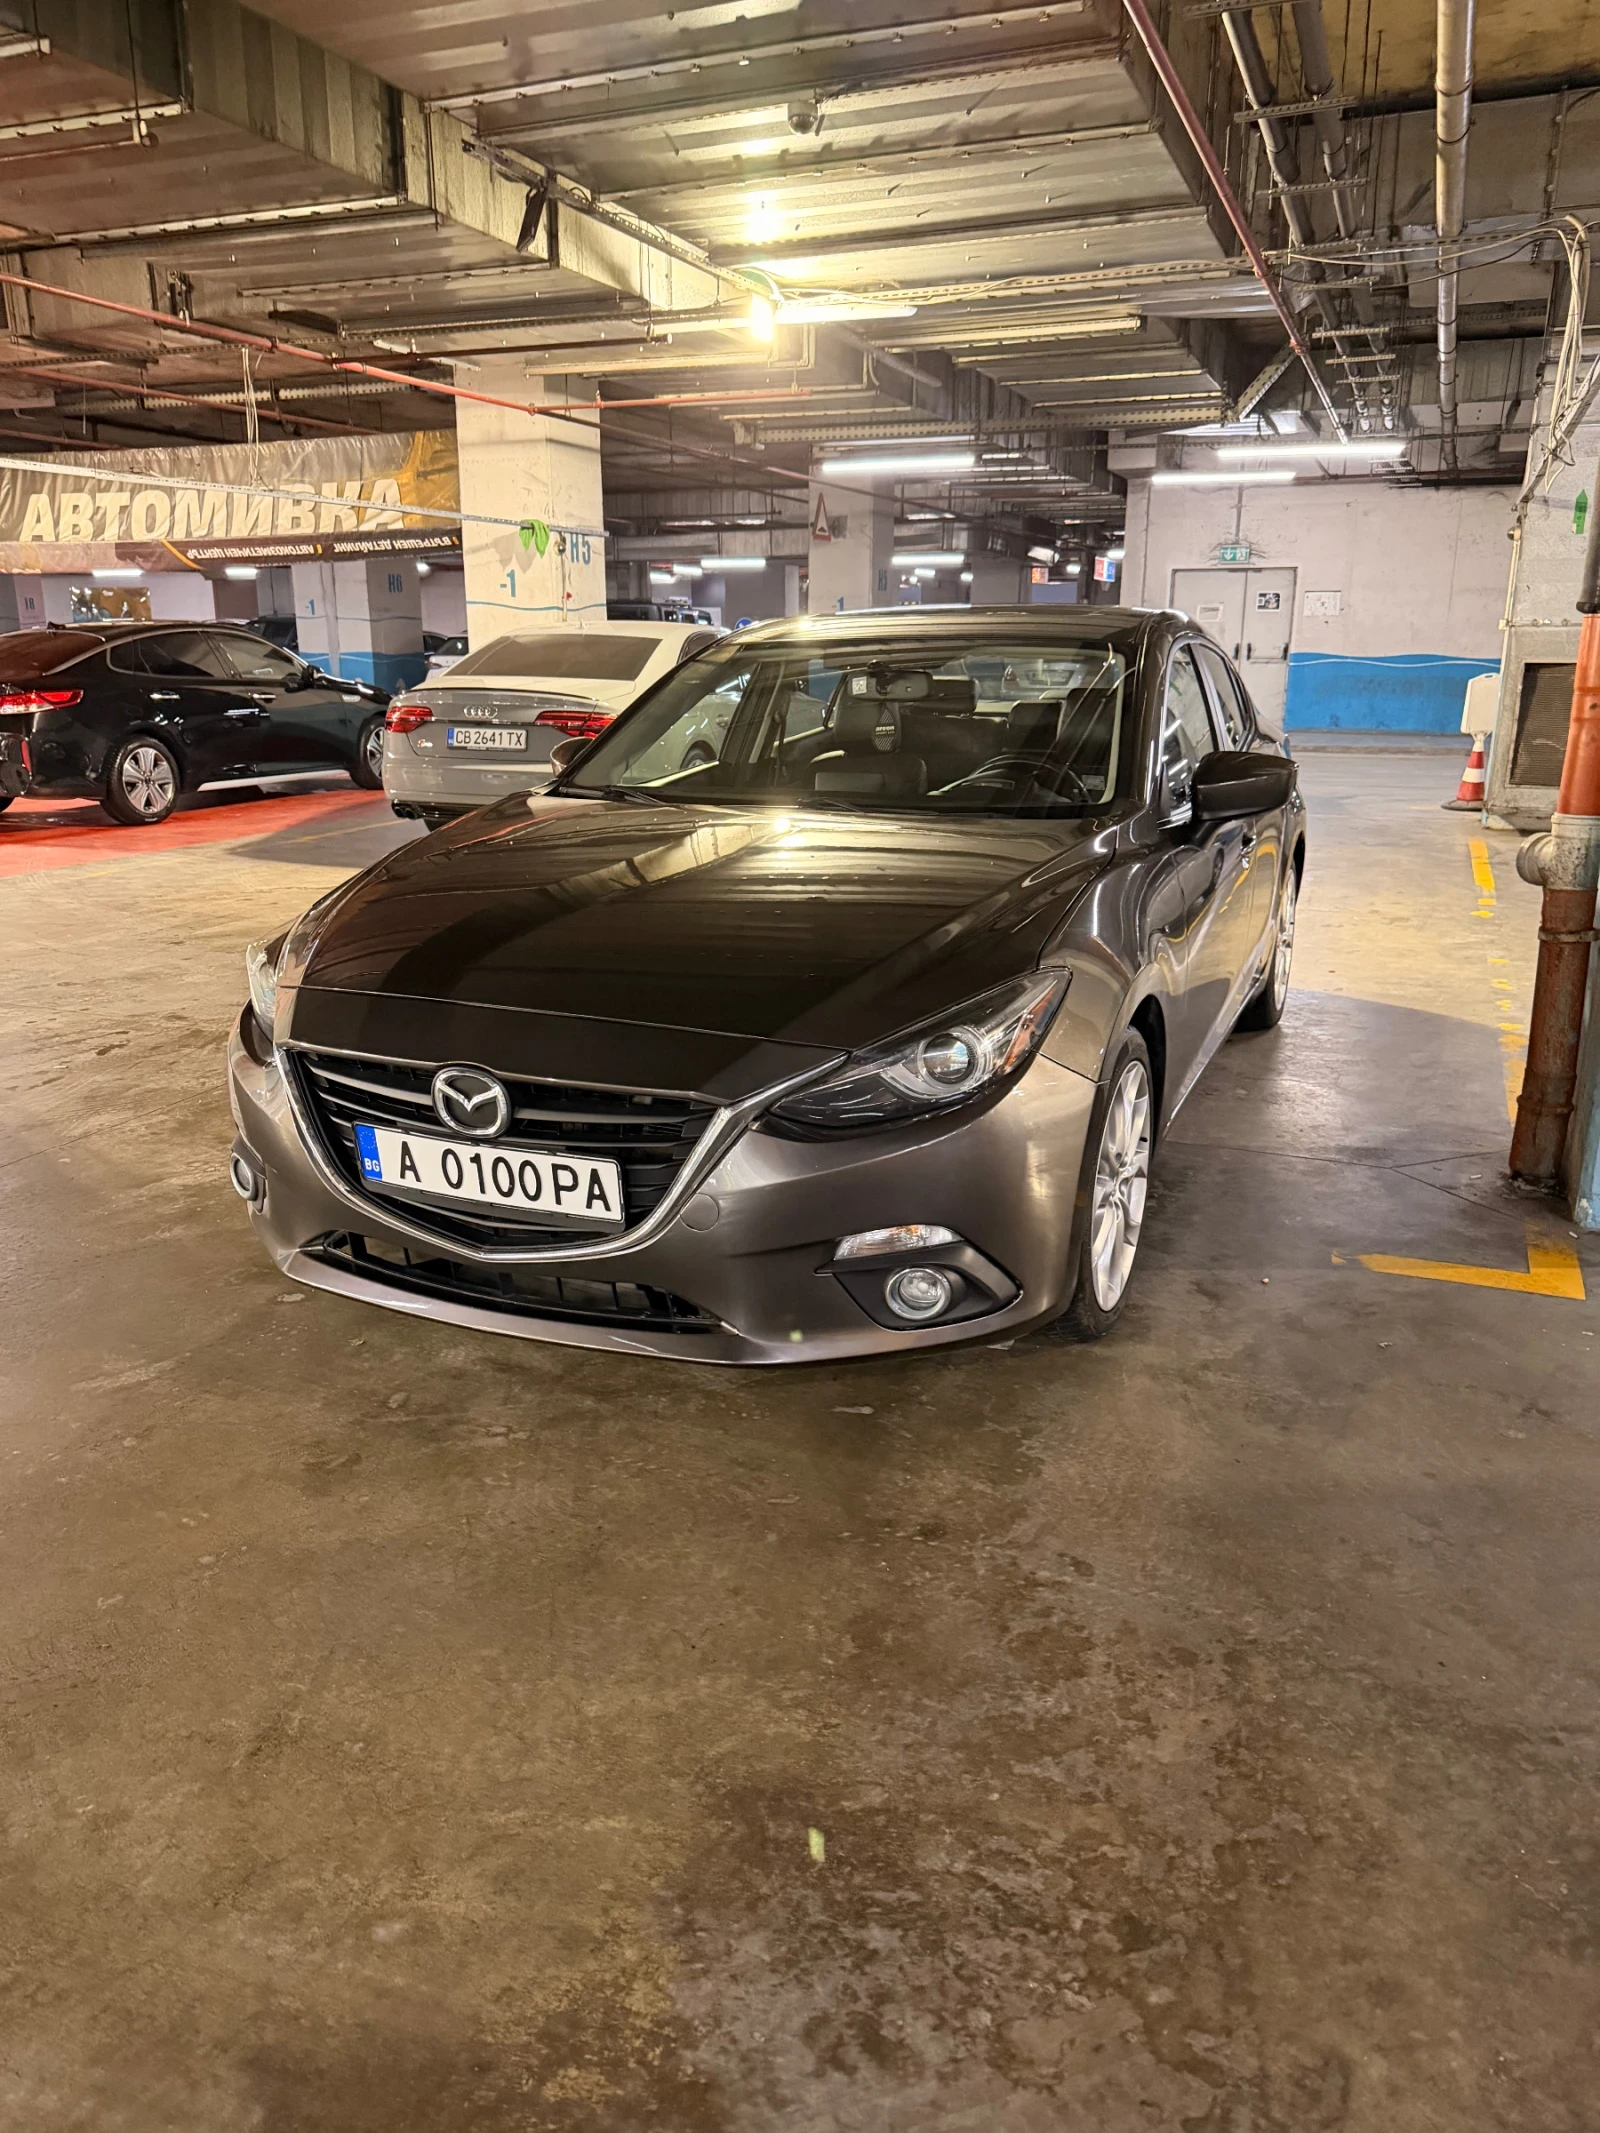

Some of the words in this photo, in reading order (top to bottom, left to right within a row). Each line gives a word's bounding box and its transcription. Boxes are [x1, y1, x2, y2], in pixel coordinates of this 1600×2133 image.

[19, 478, 404, 542] АВТОМИВКА
[392, 536, 452, 550] ВЪТРЕШЕН
[186, 547, 226, 559] ЦЕНТЪР
[223, 544, 315, 558] АВТОКОЗМЕТИЧЕН
[500, 569, 516, 598] -1
[455, 730, 472, 745] CB
[474, 731, 503, 746] 2641
[507, 731, 524, 747] TX
[364, 1158, 381, 1172] BG
[400, 1140, 422, 1183] A
